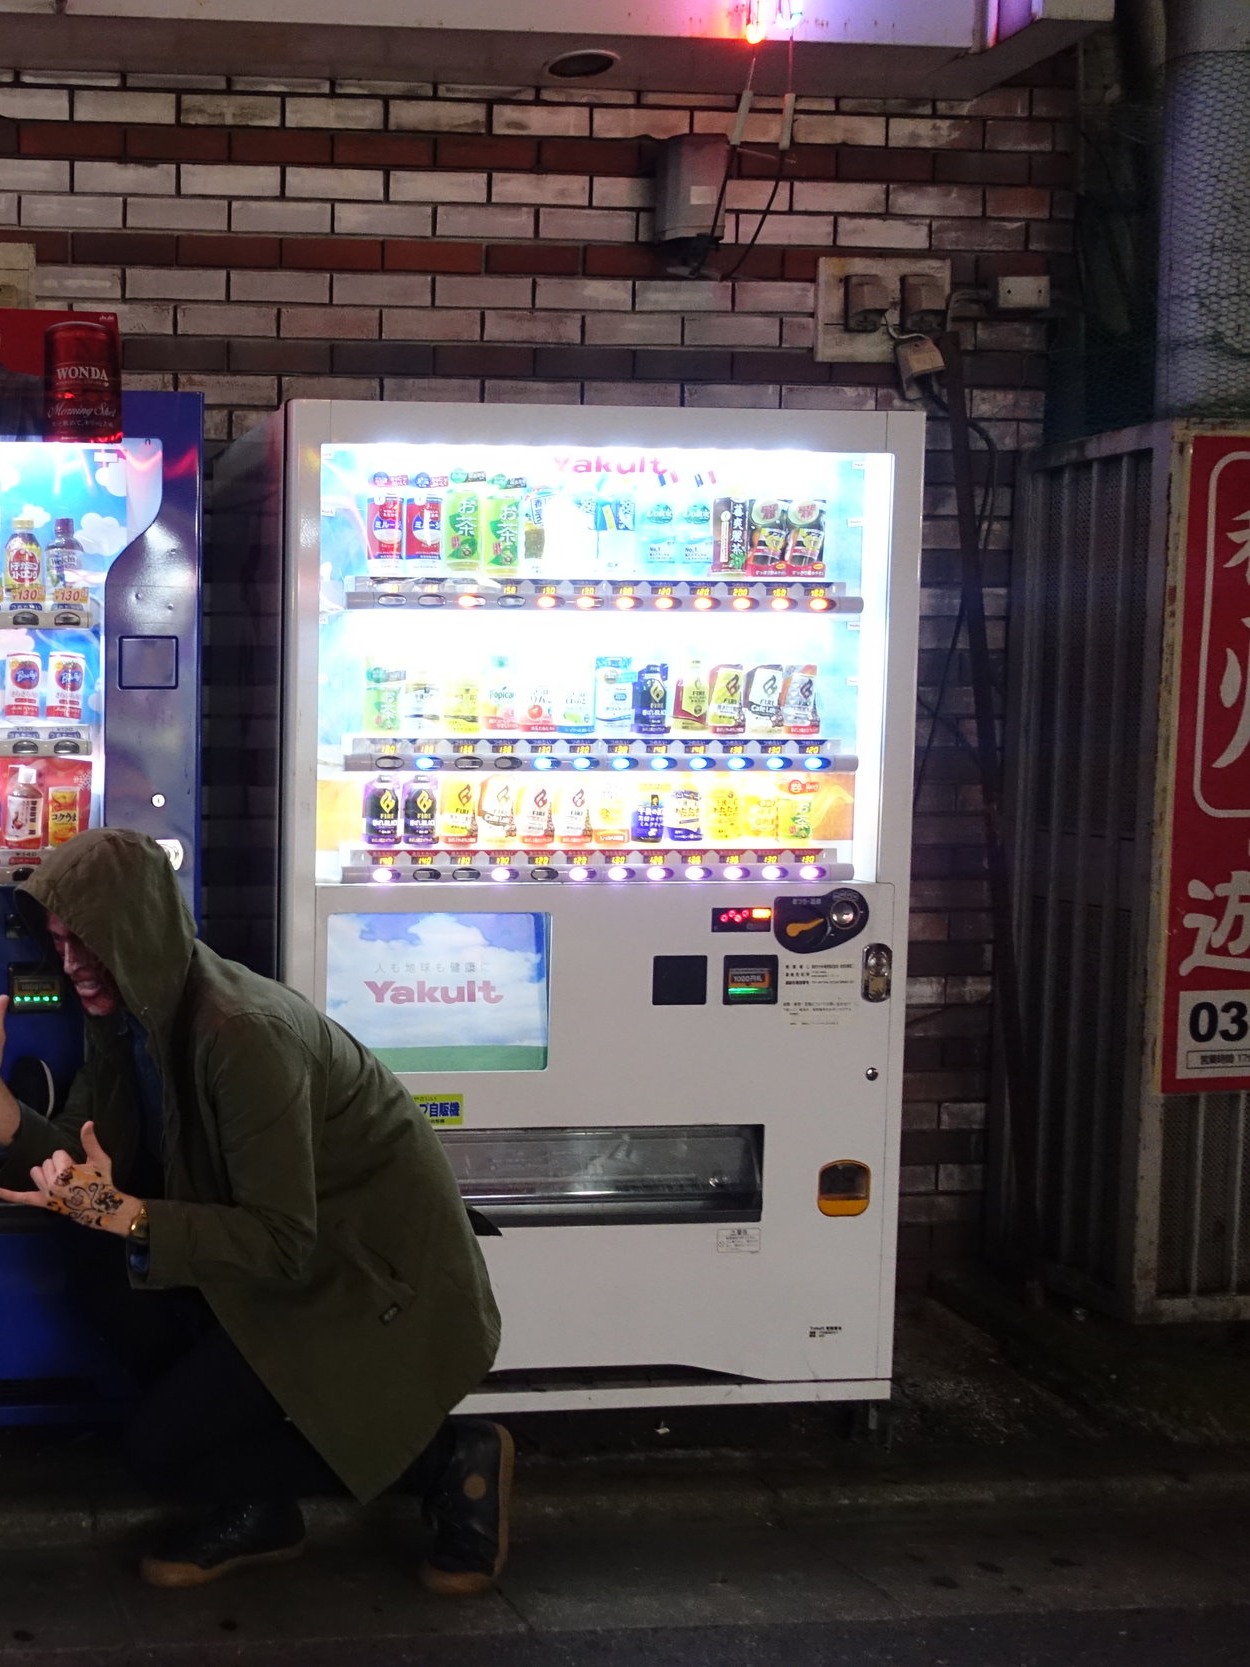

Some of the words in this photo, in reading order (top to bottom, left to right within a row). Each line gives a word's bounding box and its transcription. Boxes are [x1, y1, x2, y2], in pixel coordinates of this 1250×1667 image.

[56, 366, 108, 381] WONDA
[554, 455, 668, 475] Yakult
[457, 499, 477, 537] お茶
[500, 505, 519, 544] お茶
[13, 590, 38, 600] ¥130
[55, 591, 80, 601] ¥130
[374, 962, 490, 974] 人も地球も健康に
[363, 980, 504, 1004] Yakult
